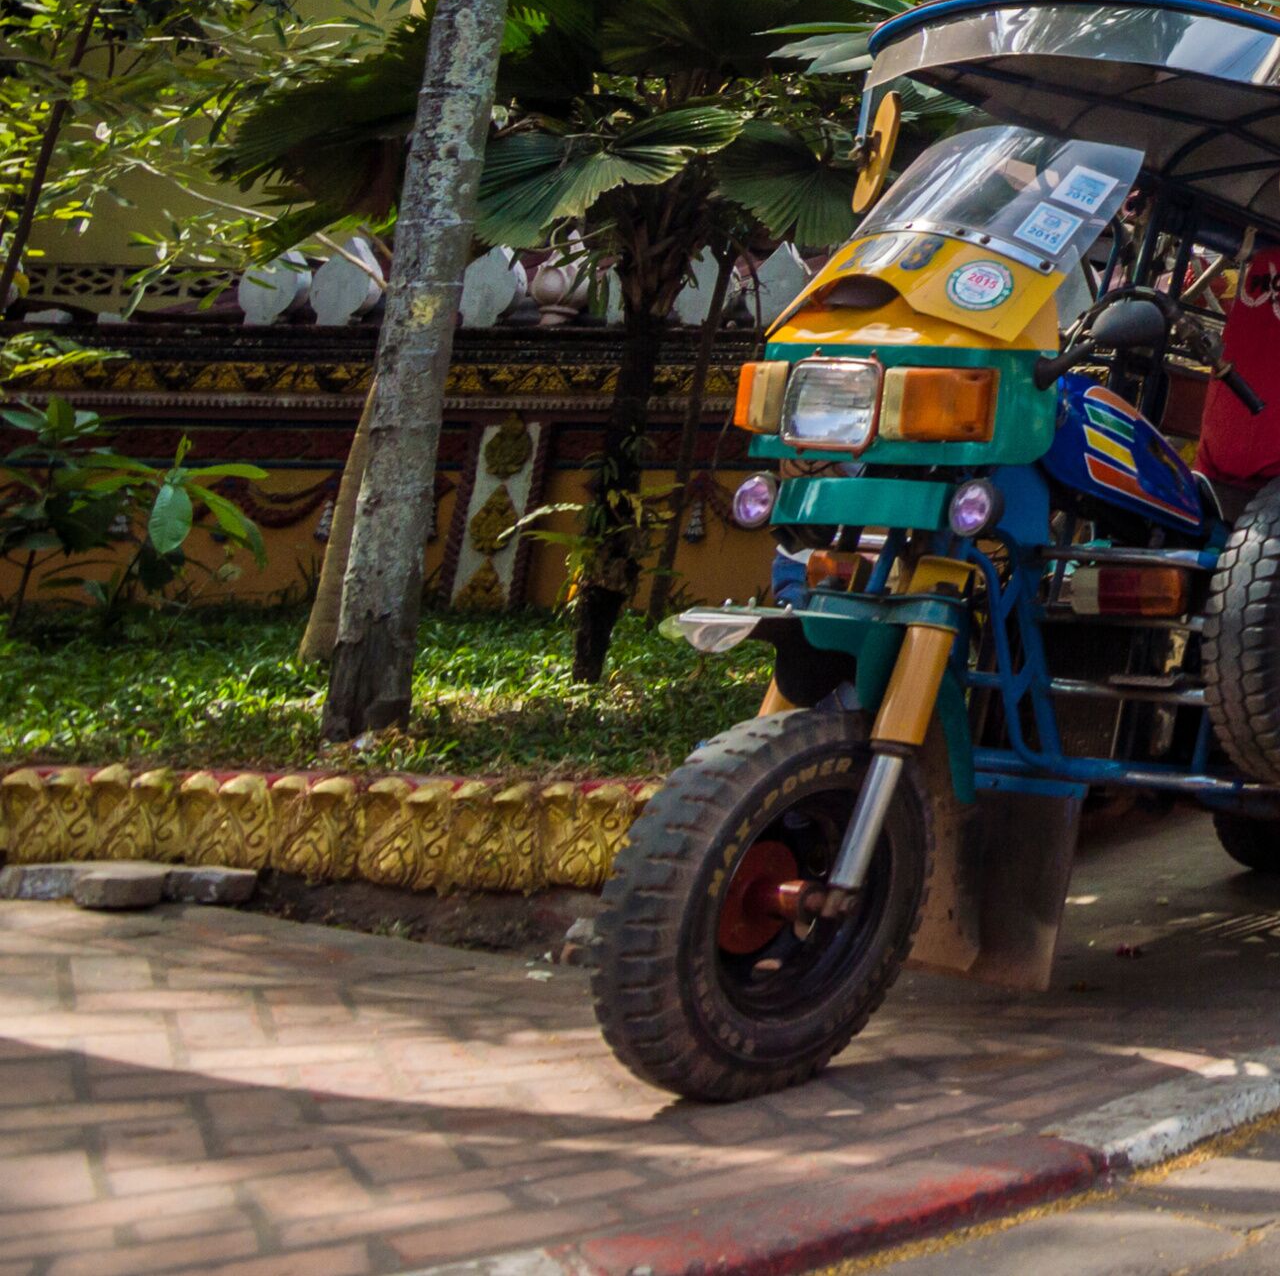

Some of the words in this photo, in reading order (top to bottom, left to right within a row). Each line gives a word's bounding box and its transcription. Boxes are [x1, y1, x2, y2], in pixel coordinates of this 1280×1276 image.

[1064, 189, 1095, 206] 2016
[1027, 227, 1058, 244] 2015
[967, 272, 999, 290] 2015
